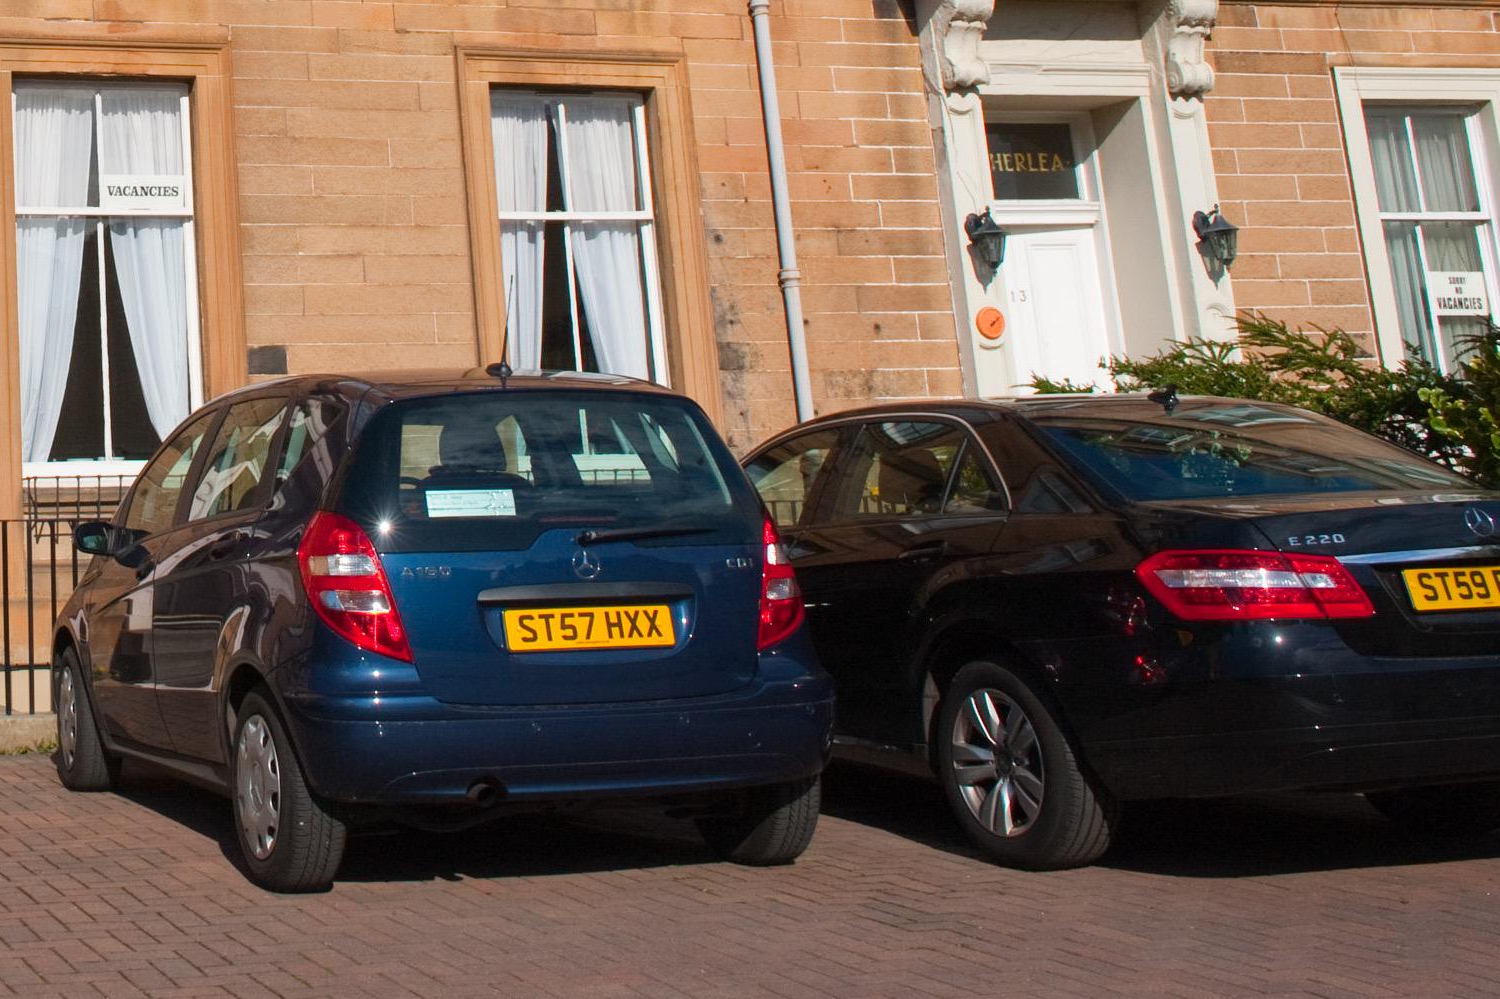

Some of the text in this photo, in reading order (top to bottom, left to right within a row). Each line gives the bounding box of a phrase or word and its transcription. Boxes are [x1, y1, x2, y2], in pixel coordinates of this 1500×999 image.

[107, 185, 179, 197] VACANCIES
[1455, 287, 1463, 295] NO
[1437, 297, 1483, 310] VACANCIES
[1417, 570, 1491, 602] ST59
[518, 609, 663, 643] ST57 HXX
